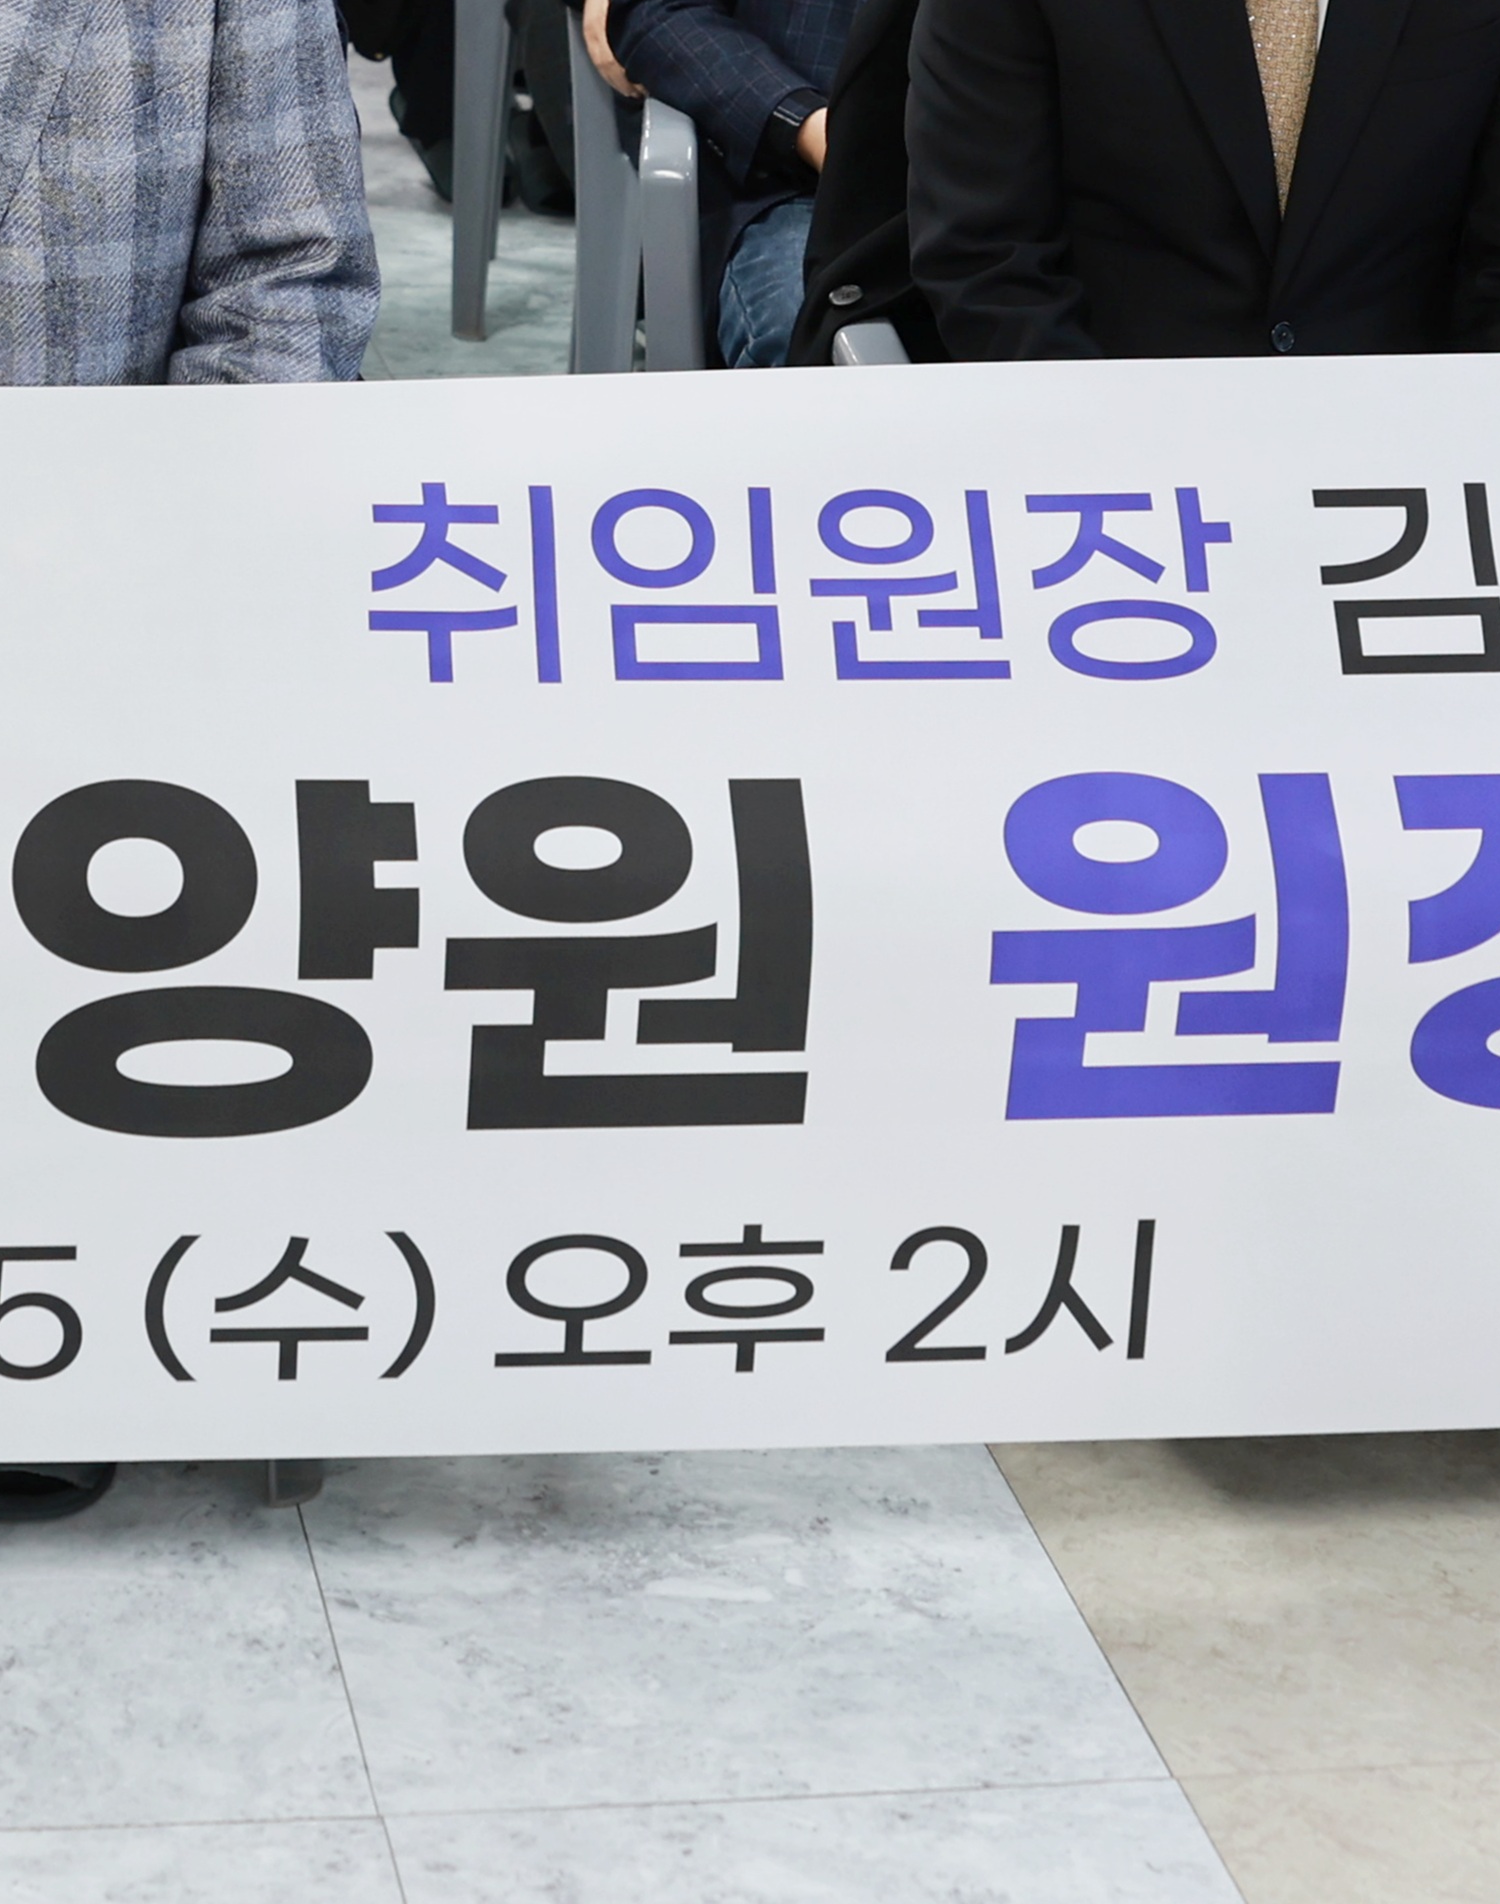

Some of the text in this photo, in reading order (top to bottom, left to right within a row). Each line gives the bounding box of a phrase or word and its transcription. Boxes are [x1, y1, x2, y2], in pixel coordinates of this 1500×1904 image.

[368, 482, 1232, 684] 취임원장
[494, 1223, 826, 1373] 오후
[884, 1218, 1157, 1364] 2시
